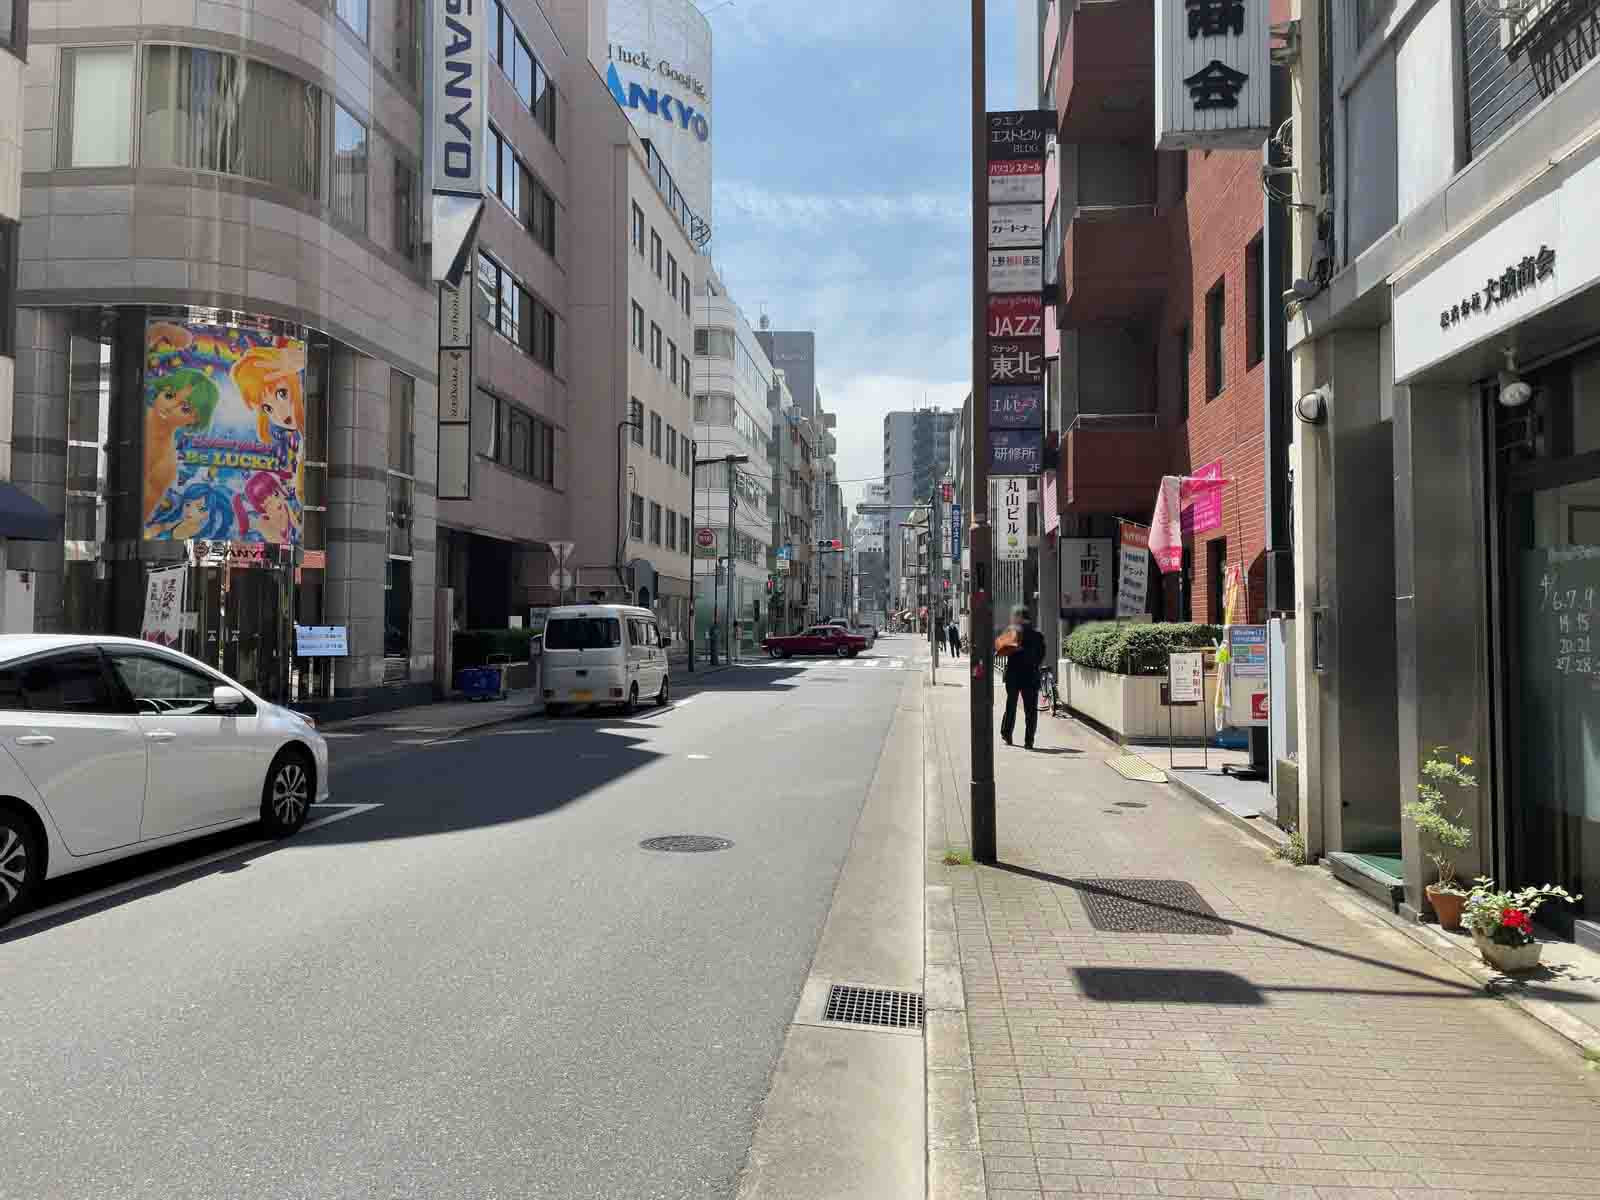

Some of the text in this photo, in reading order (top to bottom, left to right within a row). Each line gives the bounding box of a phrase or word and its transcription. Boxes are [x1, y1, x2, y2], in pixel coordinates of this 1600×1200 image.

[989, 315, 1041, 337] JAZZ
[990, 351, 1041, 379] 東北
[992, 447, 1035, 461] 研修所
[1006, 479, 1020, 535] 丸山ビル
